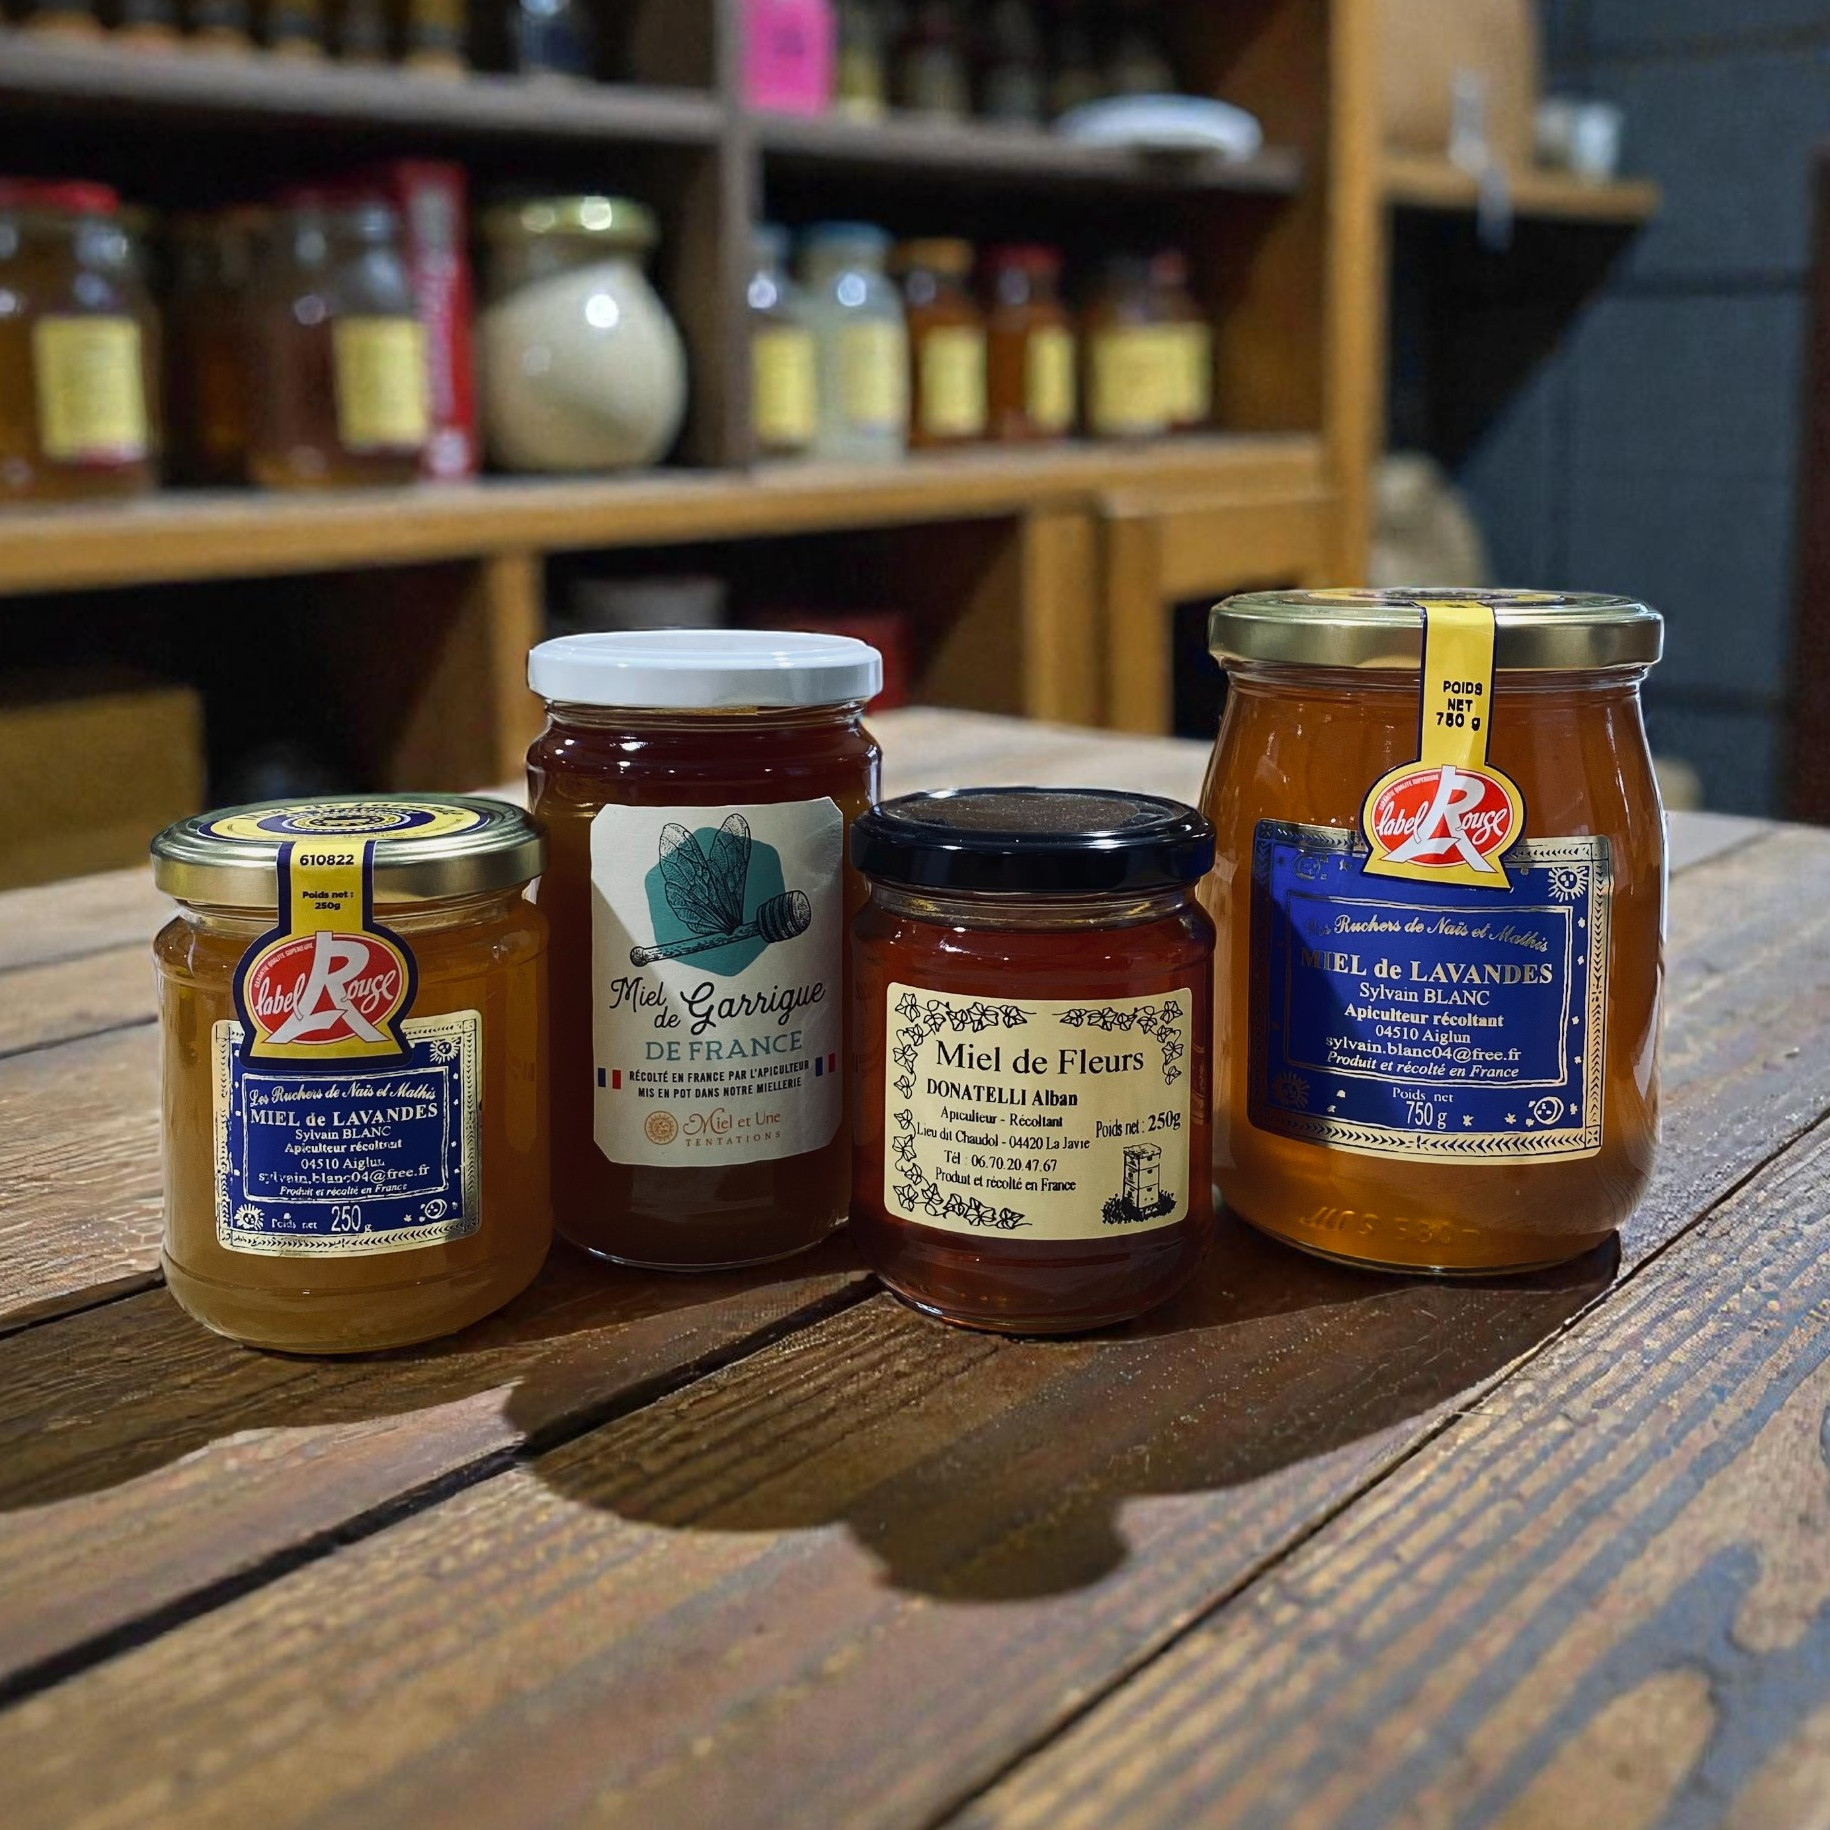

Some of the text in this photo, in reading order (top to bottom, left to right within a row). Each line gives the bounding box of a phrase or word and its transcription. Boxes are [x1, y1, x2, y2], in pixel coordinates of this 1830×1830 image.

[1443, 680, 1483, 696] POIDS
[1447, 698, 1473, 713] NET
[1376, 800, 1429, 844] label
[300, 854, 354, 866] 610822
[302, 891, 330, 900] Poids
[331, 891, 348, 900] net
[315, 902, 341, 911] 250g
[1334, 914, 1401, 934] Ruchers
[1404, 917, 1425, 933] de
[1427, 916, 1469, 937] Naïs
[1471, 923, 1491, 939] et
[1301, 947, 1553, 985] MIEL de LAVANDES
[255, 972, 306, 1021] label
[609, 976, 826, 1036] Miel de Garrigue
[1359, 982, 1490, 1006] Sylvain BLANC
[1344, 1003, 1504, 1027] Apiculteur récoltant
[645, 1030, 803, 1061] DE FRANCE
[1376, 1025, 1471, 1046] 04510 Aiglun
[936, 1039, 1144, 1075] Miel de Fleurs
[1325, 1035, 1521, 1063] sylvain.blanc04@free.fr
[629, 1060, 809, 1083] RÉCOLTÉ EN FRANCE PAR L'APICULTEUR
[1327, 1051, 1520, 1078] Produit et récolté en France
[324, 1084, 340, 1099] de
[376, 1085, 387, 1097] et
[638, 1077, 802, 1099] MIS EN POT DANS NOTRE MIELLERIE
[926, 1078, 1079, 1107] DONATELLI Alban
[1393, 1087, 1454, 1103] Poids net
[250, 1103, 439, 1127] MIEL de LAVANDES
[682, 1107, 781, 1135] Miel et Une
[940, 1106, 998, 1125] Apiculteur
[1009, 1113, 1063, 1128] Récoltant
[1096, 1119, 1122, 1138] Poids
[1125, 1119, 1140, 1136] net
[1147, 1110, 1181, 1131] 250g
[1406, 1100, 1448, 1130] 750 g
[295, 1126, 392, 1143] Sylvain BLANC
[686, 1130, 781, 1147] TENTATIONS
[916, 1122, 937, 1138] Lieu
[939, 1127, 953, 1141] dit
[955, 1130, 999, 1147] Chaudol
[1009, 1136, 1043, 1150] 04420
[1046, 1137, 1060, 1151] La
[1062, 1137, 1091, 1150] Javie
[284, 1143, 345, 1156] Apiculteur
[944, 1149, 961, 1165] Tél
[971, 1154, 1058, 1173] 06.70.20.47.67
[300, 1158, 339, 1170] 04510
[279, 1185, 314, 1197] Produit
[326, 1184, 359, 1196] récolté
[360, 1185, 373, 1194] en
[375, 1183, 408, 1194] France
[935, 1166, 1076, 1192] Produit et récolté en France
[331, 1205, 362, 1232] 250
